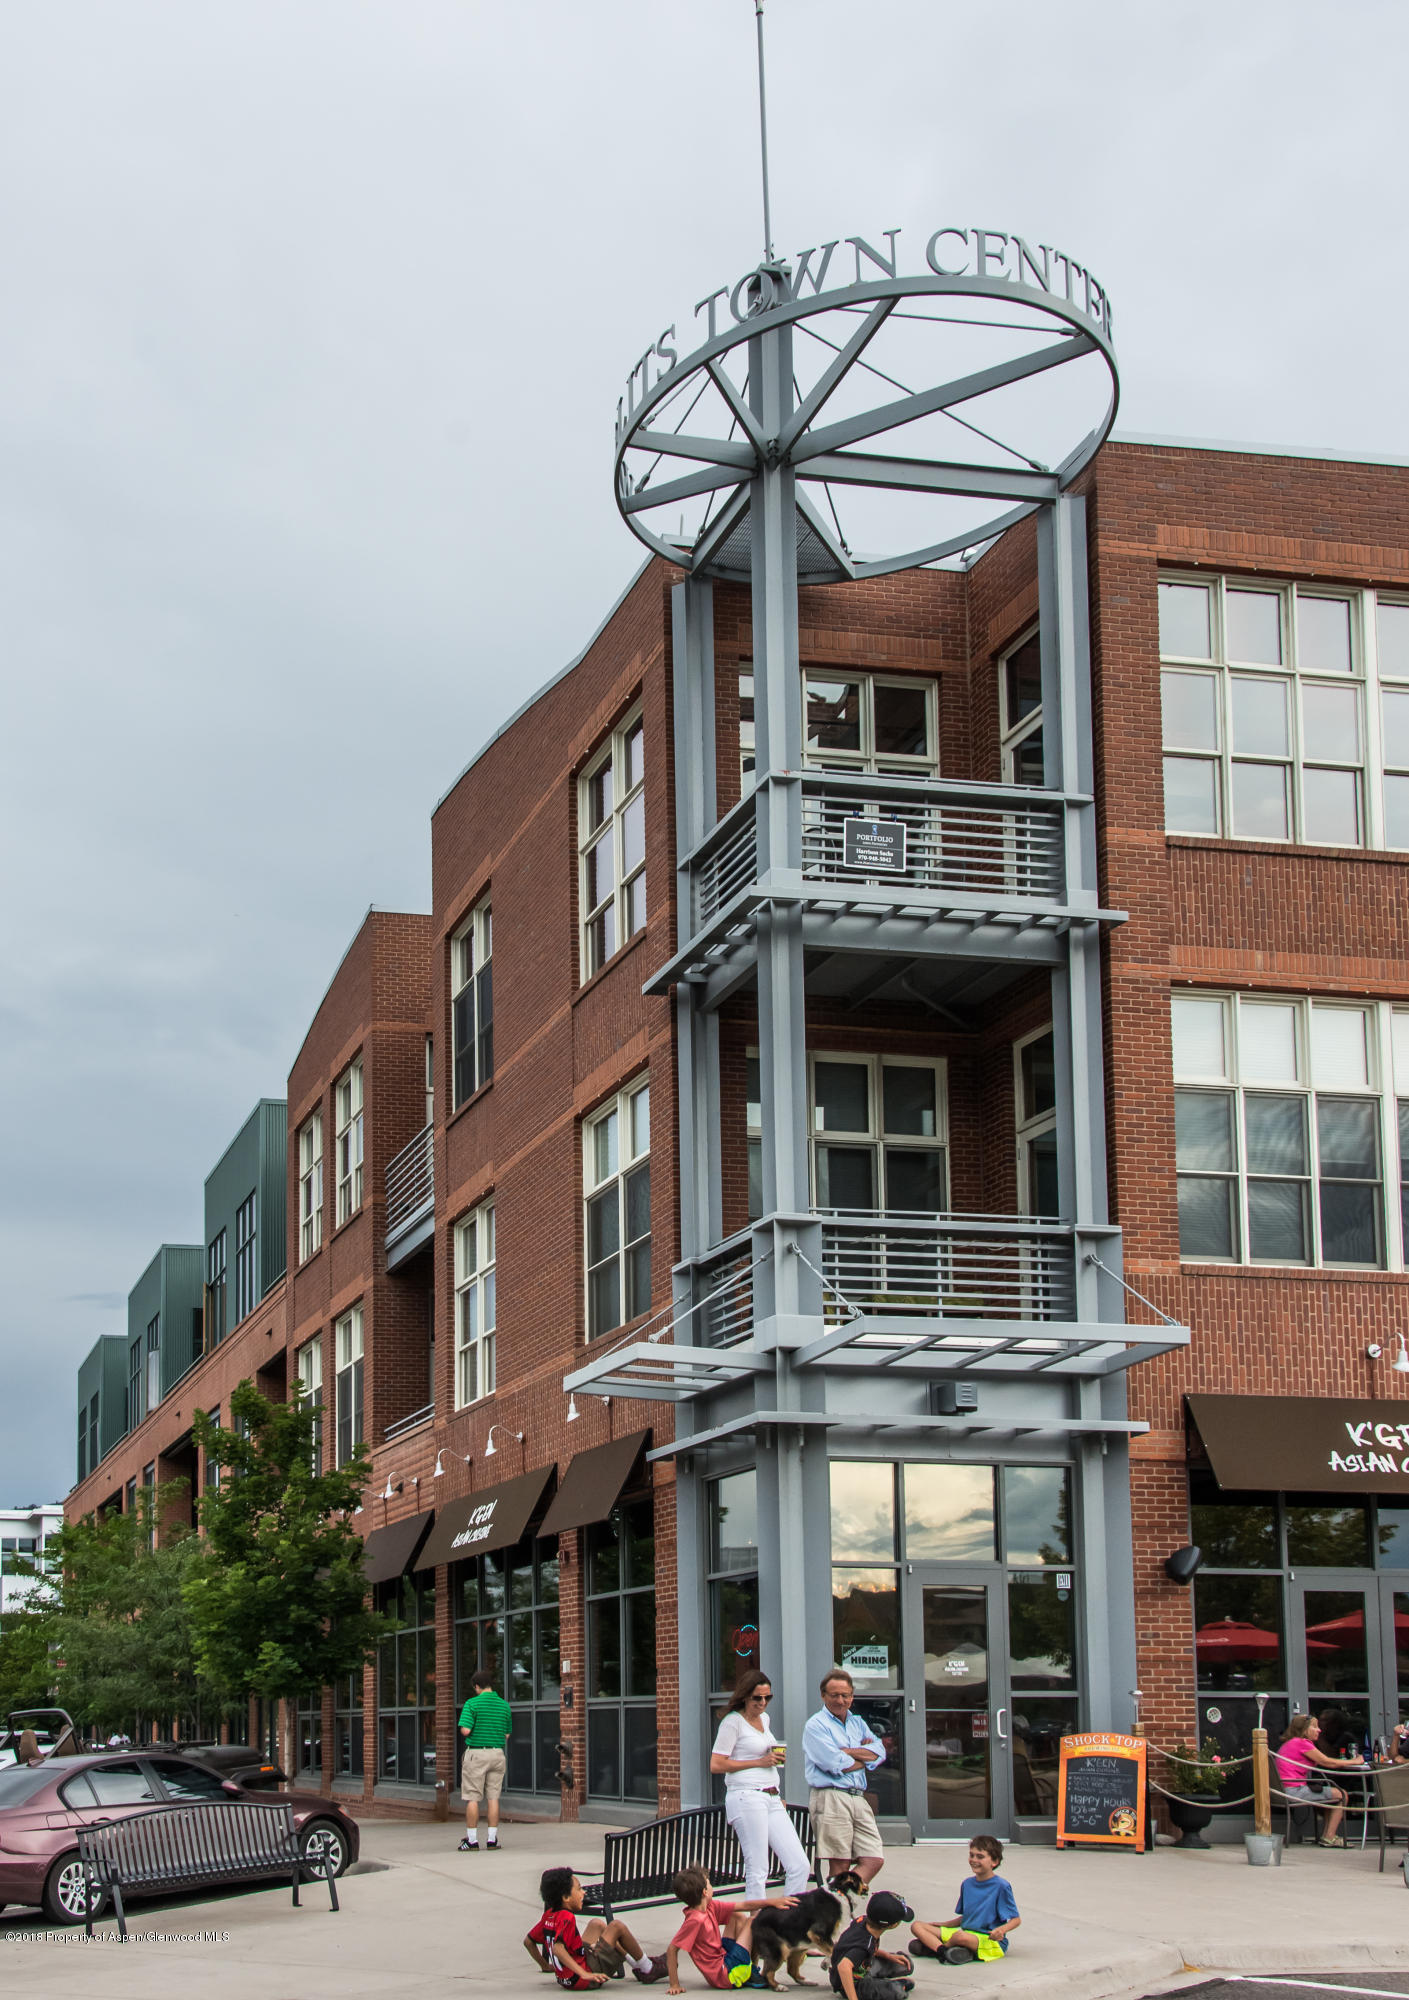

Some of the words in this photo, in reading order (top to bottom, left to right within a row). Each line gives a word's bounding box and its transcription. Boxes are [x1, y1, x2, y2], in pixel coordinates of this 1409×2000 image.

[695, 228, 901, 343] TOWN
[856, 833, 893, 843] PORTFOLIO
[1328, 1450, 1398, 1473] ASIAN
[850, 1656, 888, 1665] HIRING
[1064, 1734, 1111, 1748] SHOCK
[1115, 1735, 1144, 1749] TOP
